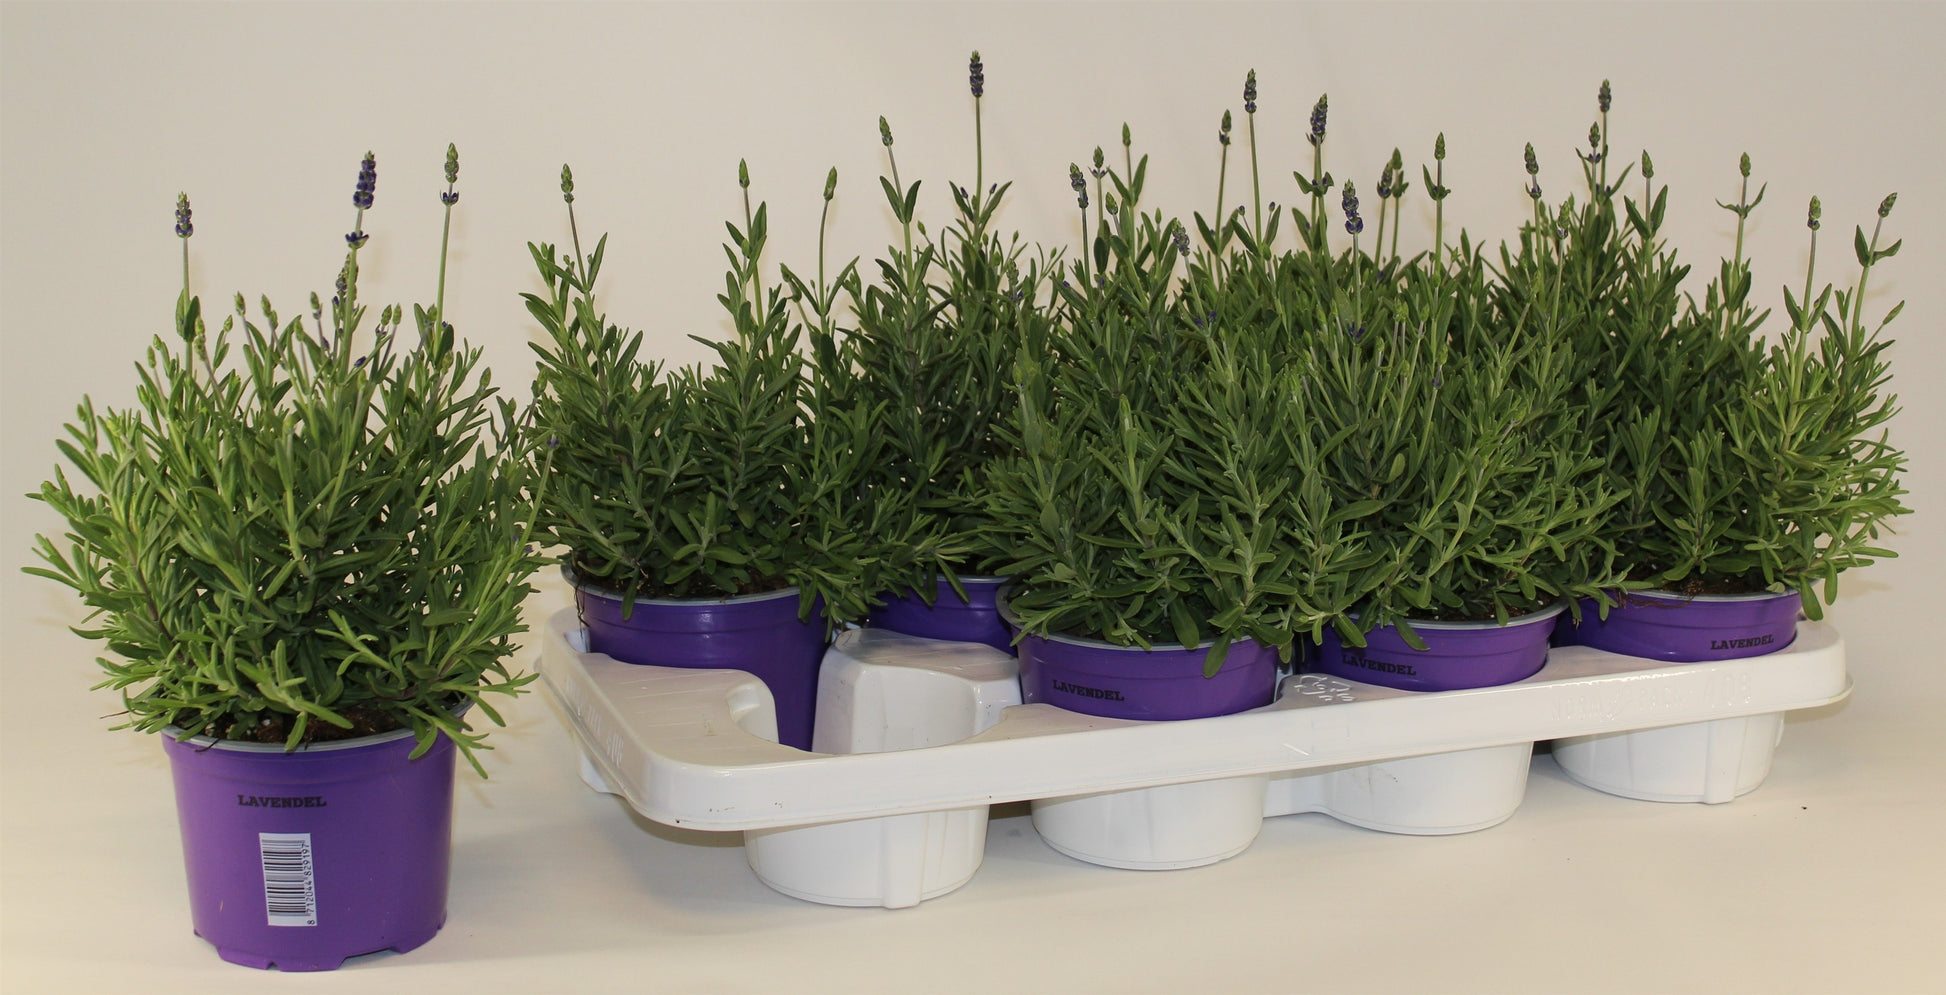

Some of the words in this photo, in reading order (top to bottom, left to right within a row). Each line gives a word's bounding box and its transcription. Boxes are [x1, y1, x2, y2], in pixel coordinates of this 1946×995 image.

[1710, 634, 1774, 650] LAVENDEL
[1342, 654, 1417, 676] LAVENDEL
[1052, 679, 1125, 701] LAVENDEL
[237, 795, 327, 808] LAVENDEL
[301, 843, 312, 877] 829197
[305, 880, 314, 914] 712044
